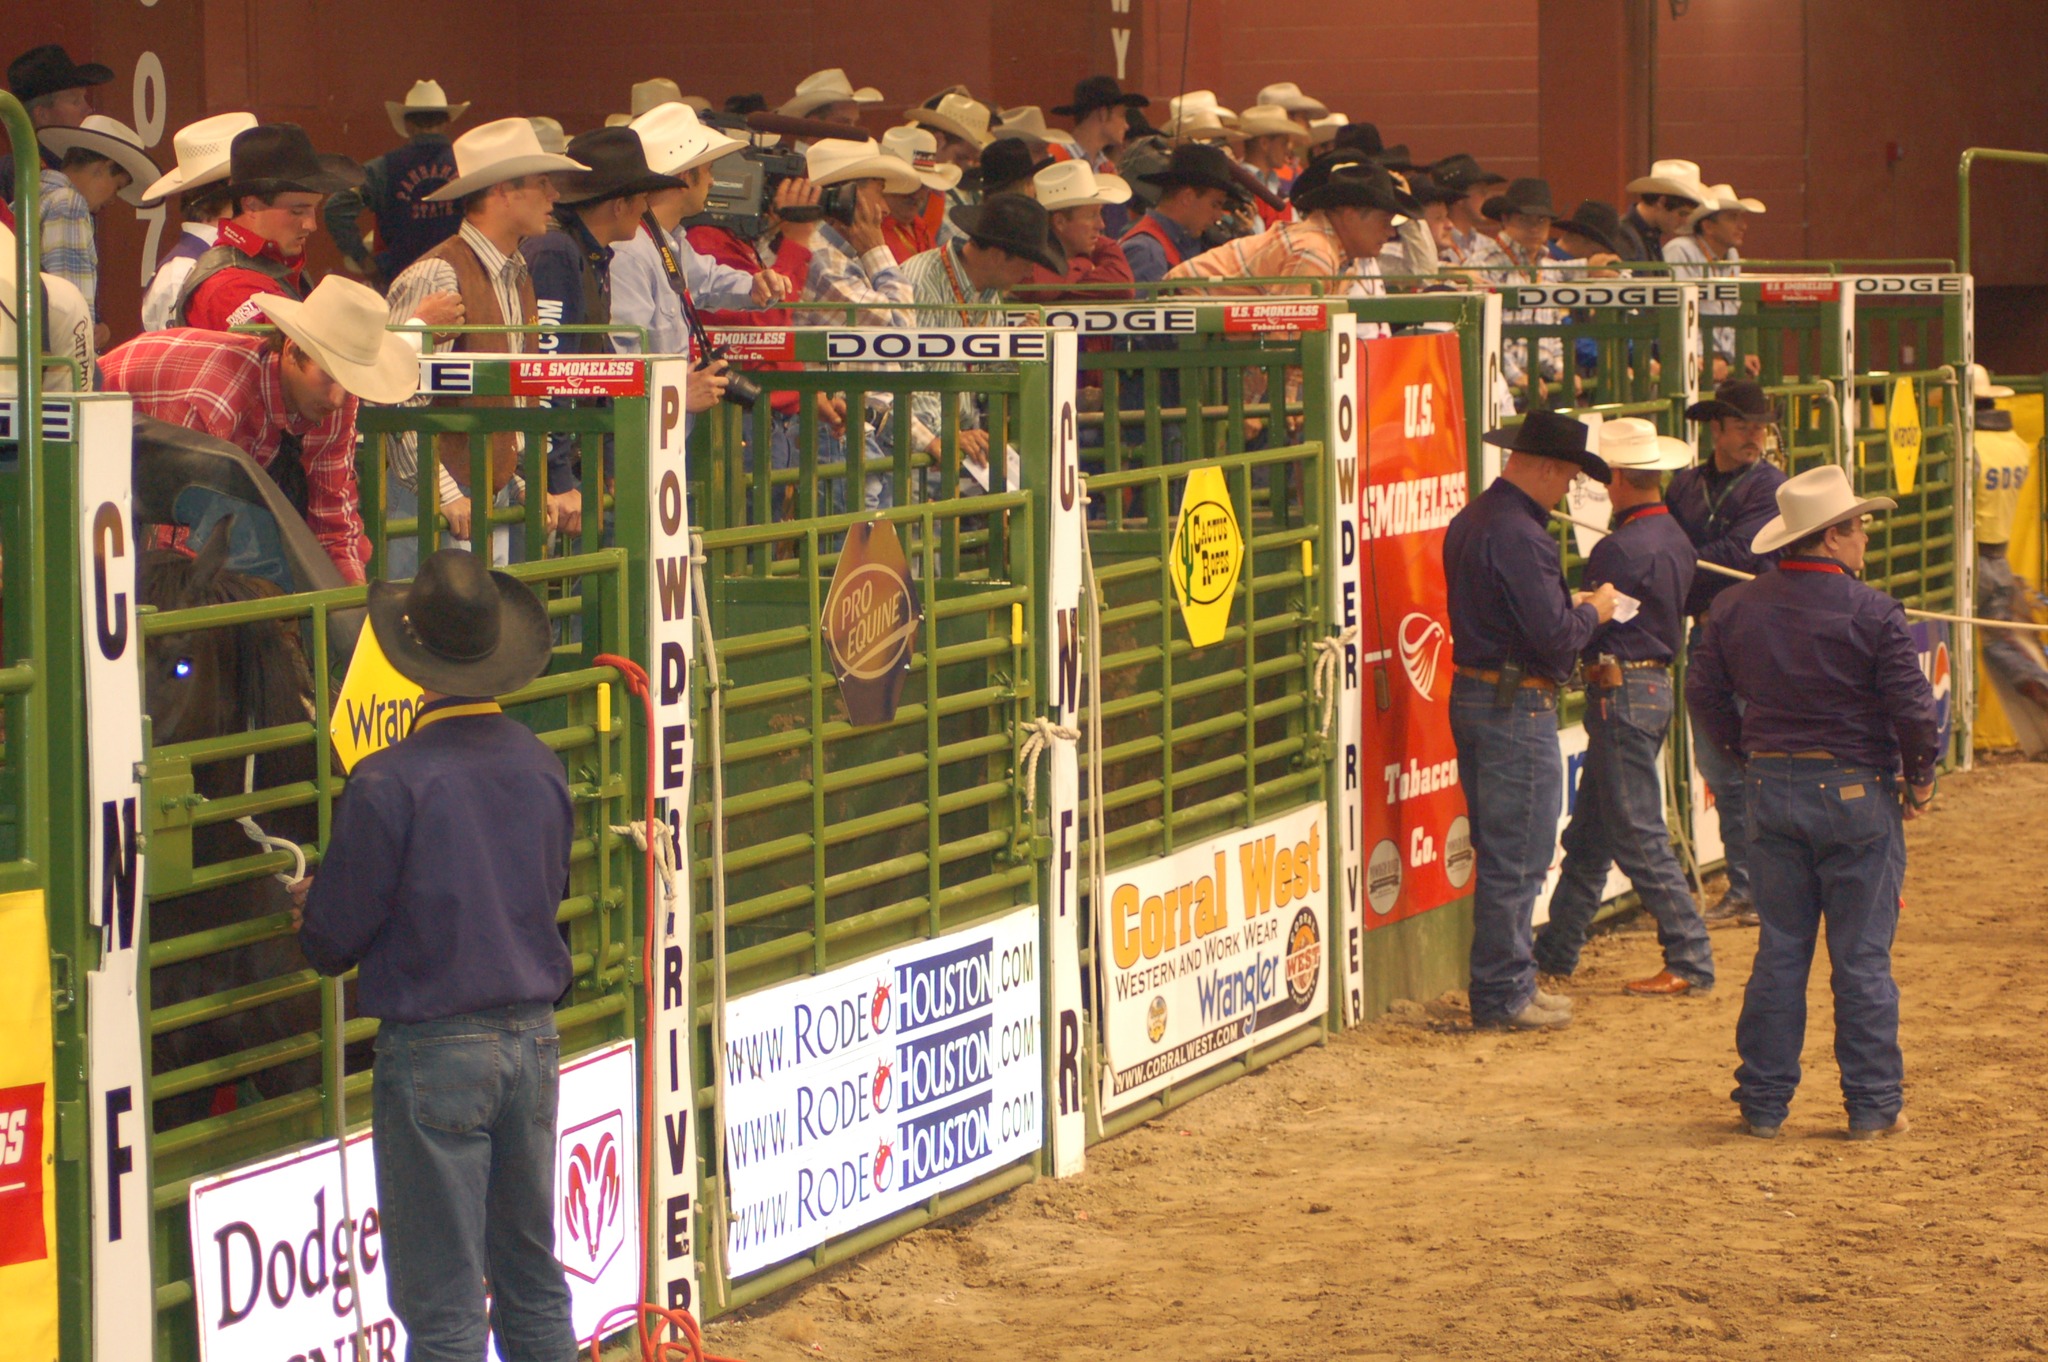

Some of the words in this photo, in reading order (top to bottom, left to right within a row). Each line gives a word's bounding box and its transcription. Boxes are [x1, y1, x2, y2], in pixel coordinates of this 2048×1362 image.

[133, 0, 166, 288] 07
[1231, 306, 1250, 318] U.S.
[1252, 304, 1320, 317] SMOKELESS
[1519, 288, 1679, 305] DODGE
[1855, 278, 1961, 293] ODGE
[713, 332, 786, 345] SMOKELESS
[723, 352, 749, 360] bacco
[750, 352, 765, 360] Co.
[828, 333, 1045, 358] DODGE
[520, 362, 544, 377] U.S.
[548, 361, 634, 376] SMOKELESS
[546, 386, 585, 395] Tobacco
[592, 385, 609, 395] Co.
[1404, 383, 1435, 439] U.S.
[1337, 332, 1357, 690] POWDER
[1361, 471, 1466, 541] SMOKELESS
[1193, 513, 1228, 554] CACTUS
[841, 579, 872, 630] PRO
[847, 591, 901, 661] EQUINE
[346, 693, 425, 751] Wran
[1384, 757, 1459, 805] Tobacco
[1410, 826, 1437, 868] Co.
[1111, 850, 1228, 969] Corral
[1239, 820, 1321, 920] West
[1345, 743, 1361, 1025] RIVER
[1115, 957, 1176, 1002] WESTERN
[1179, 949, 1201, 978] AND
[1204, 932, 1240, 966] WORK
[1243, 918, 1278, 950] WEAR
[1286, 944, 1321, 978] WEST
[1197, 951, 1279, 1036] Wrangler
[1115, 1023, 1238, 1093] WWW.CORRALWEST.COM
[213, 1184, 380, 1331] Dodge
